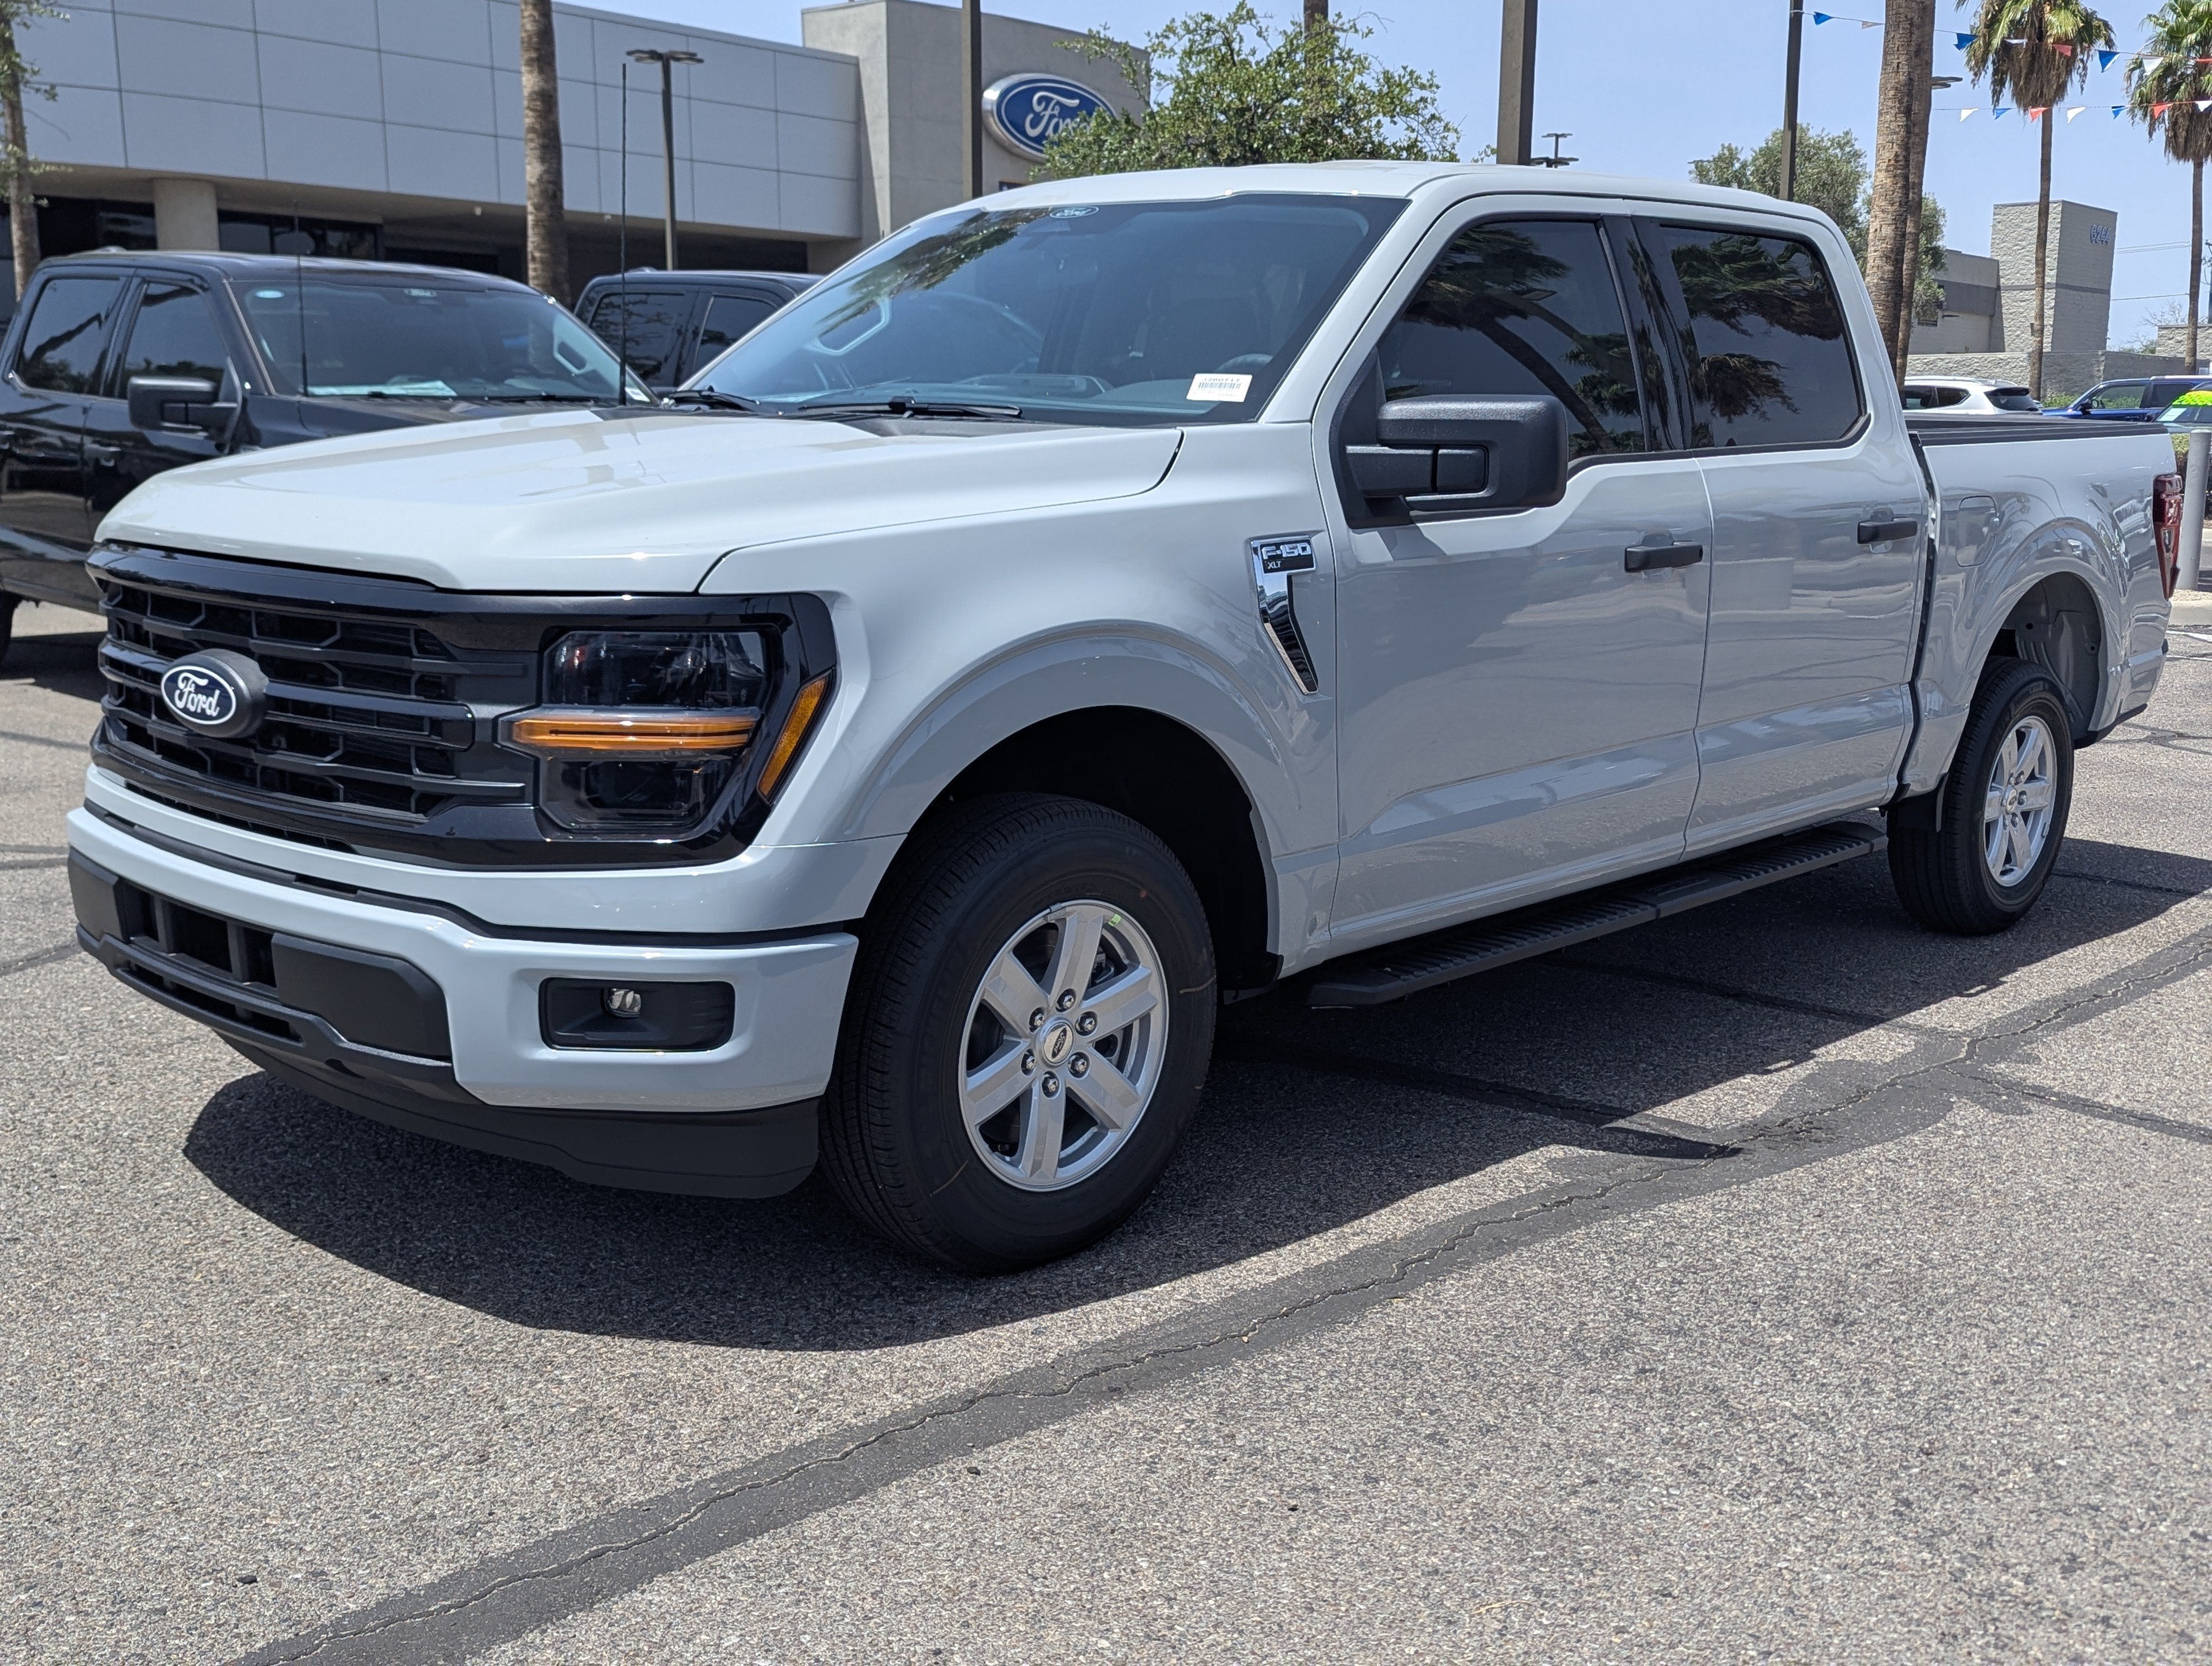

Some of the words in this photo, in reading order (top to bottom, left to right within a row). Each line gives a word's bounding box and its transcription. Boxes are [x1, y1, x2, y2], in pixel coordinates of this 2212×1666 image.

[1262, 542, 1311, 559] F-150
[1267, 561, 1281, 569] XLT
[174, 672, 220, 717] Ford
